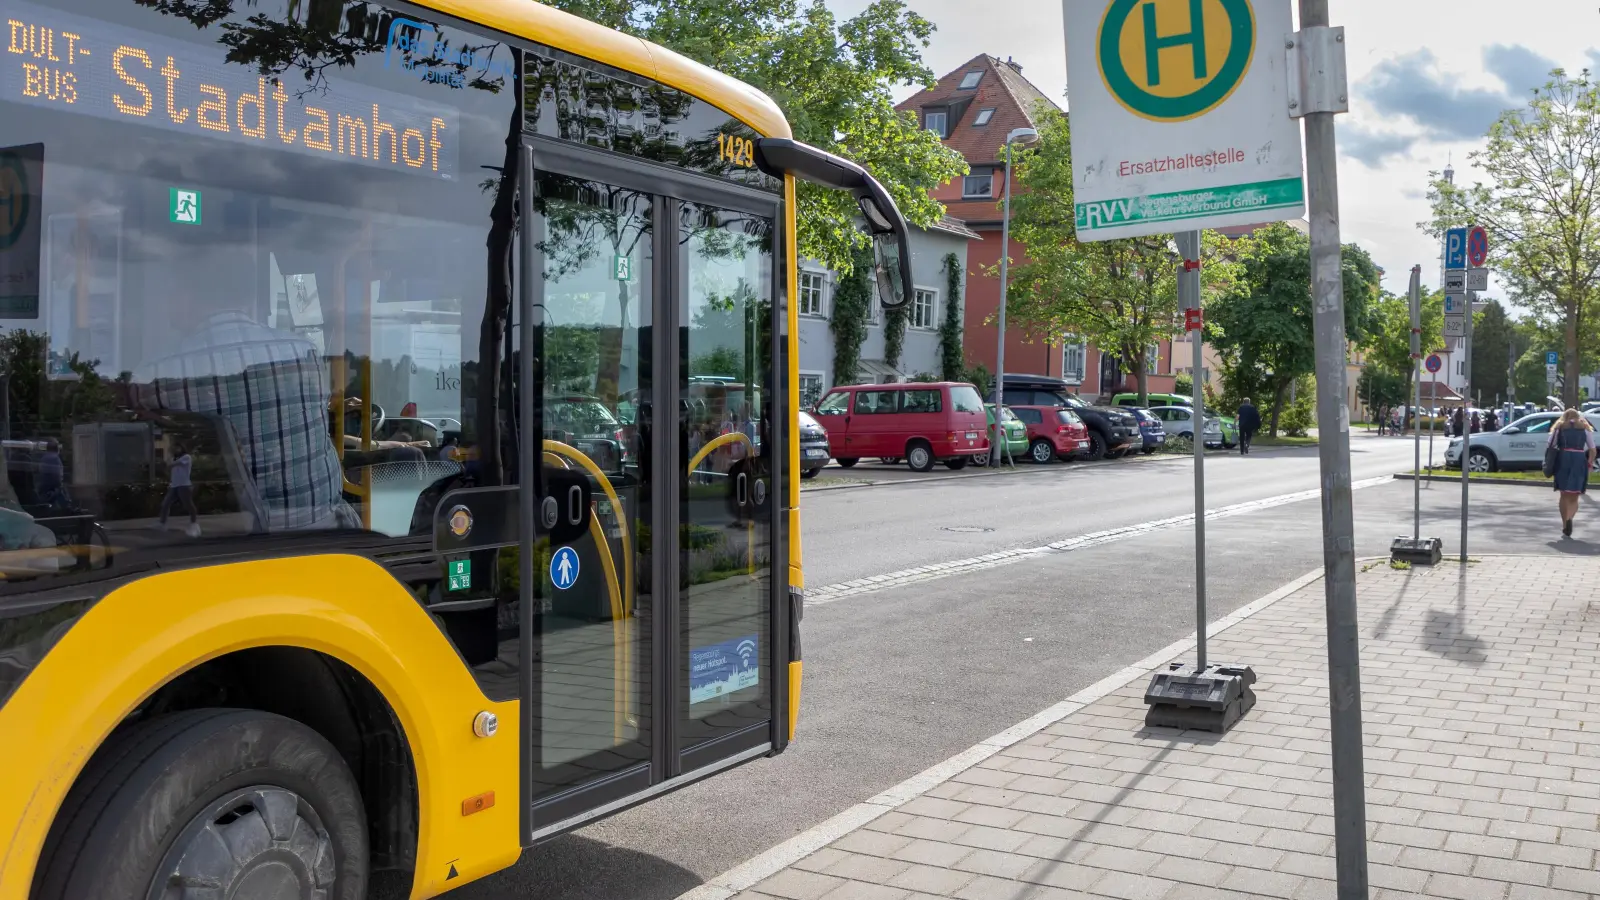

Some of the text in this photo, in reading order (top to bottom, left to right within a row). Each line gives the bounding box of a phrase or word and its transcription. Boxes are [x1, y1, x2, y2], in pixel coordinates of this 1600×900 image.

[8, 19, 91, 64] DULT-
[1142, 0, 1208, 87] H
[22, 62, 78, 103] BUS
[112, 44, 446, 171] Stadtamhof
[717, 133, 754, 168] 1429
[1119, 147, 1245, 177] Ersatzhaltestelle
[1086, 199, 1134, 228] RVV
[1232, 194, 1268, 209] GmbH
[1448, 233, 1461, 265] P
